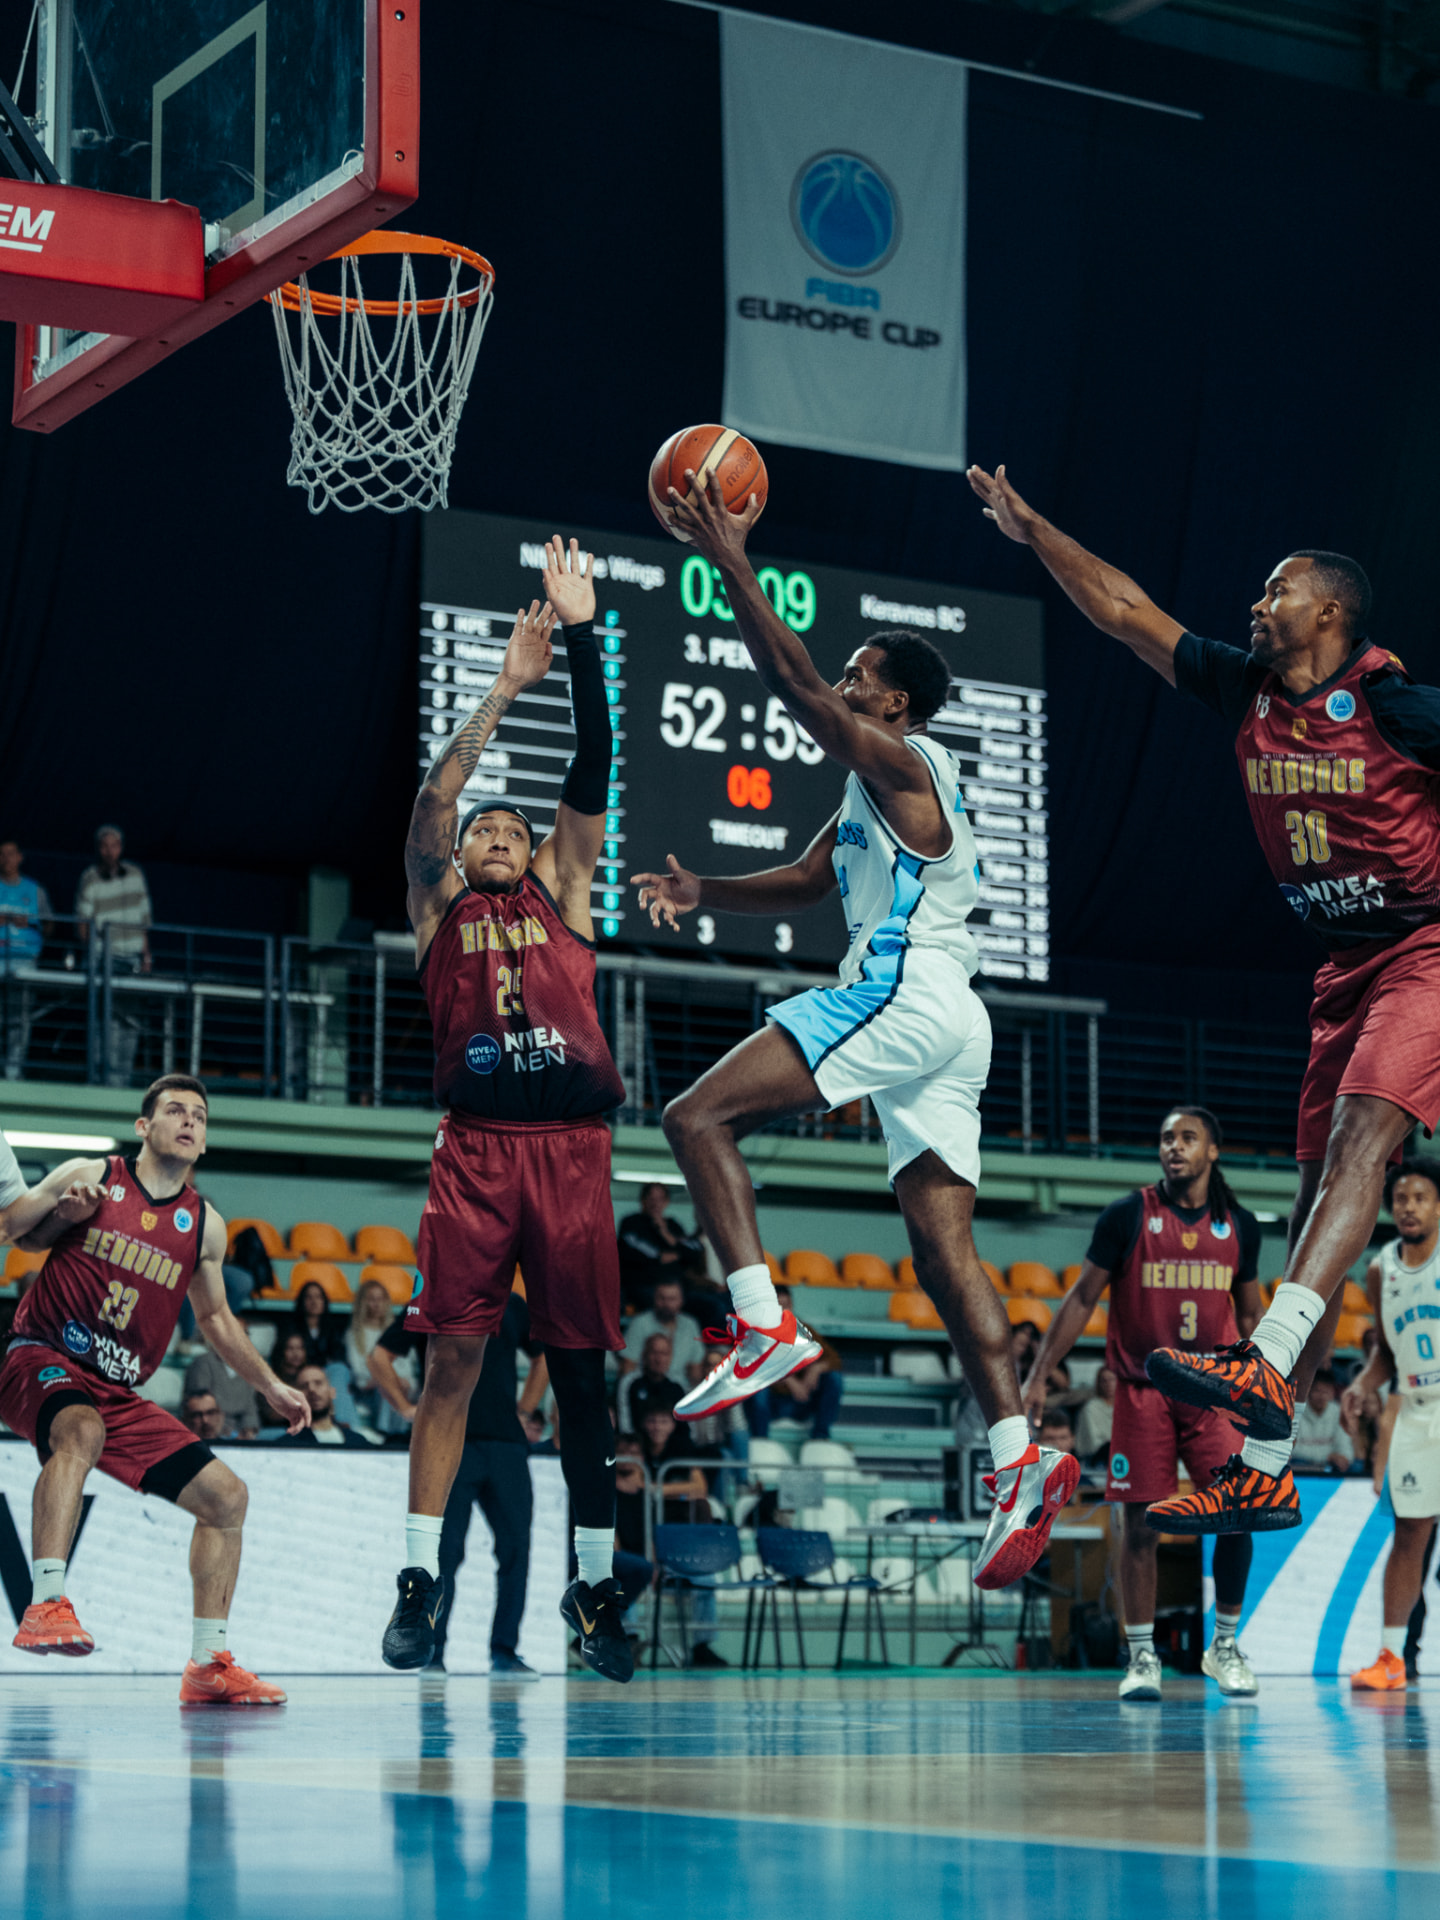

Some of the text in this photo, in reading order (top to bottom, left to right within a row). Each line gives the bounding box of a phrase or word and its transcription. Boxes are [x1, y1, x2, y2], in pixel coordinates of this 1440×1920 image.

[737, 296, 941, 350] EUROPE CUP
[937, 605, 966, 633] BC
[727, 764, 772, 810] 06
[709, 818, 788, 851] TIMEOUT
[1285, 810, 1331, 865] 30
[1301, 873, 1386, 902] NIVEA
[1320, 890, 1384, 919] MEN
[697, 915, 793, 953] 3 3
[468, 1045, 497, 1057] NIVEA
[504, 1026, 567, 1052] NIVEA
[472, 1054, 496, 1064] MEN
[513, 1046, 566, 1072] MEN
[98, 1280, 139, 1331] 23
[1179, 1300, 1198, 1340] 3
[93, 1332, 140, 1374] NIVEA
[97, 1350, 138, 1386] MEN
